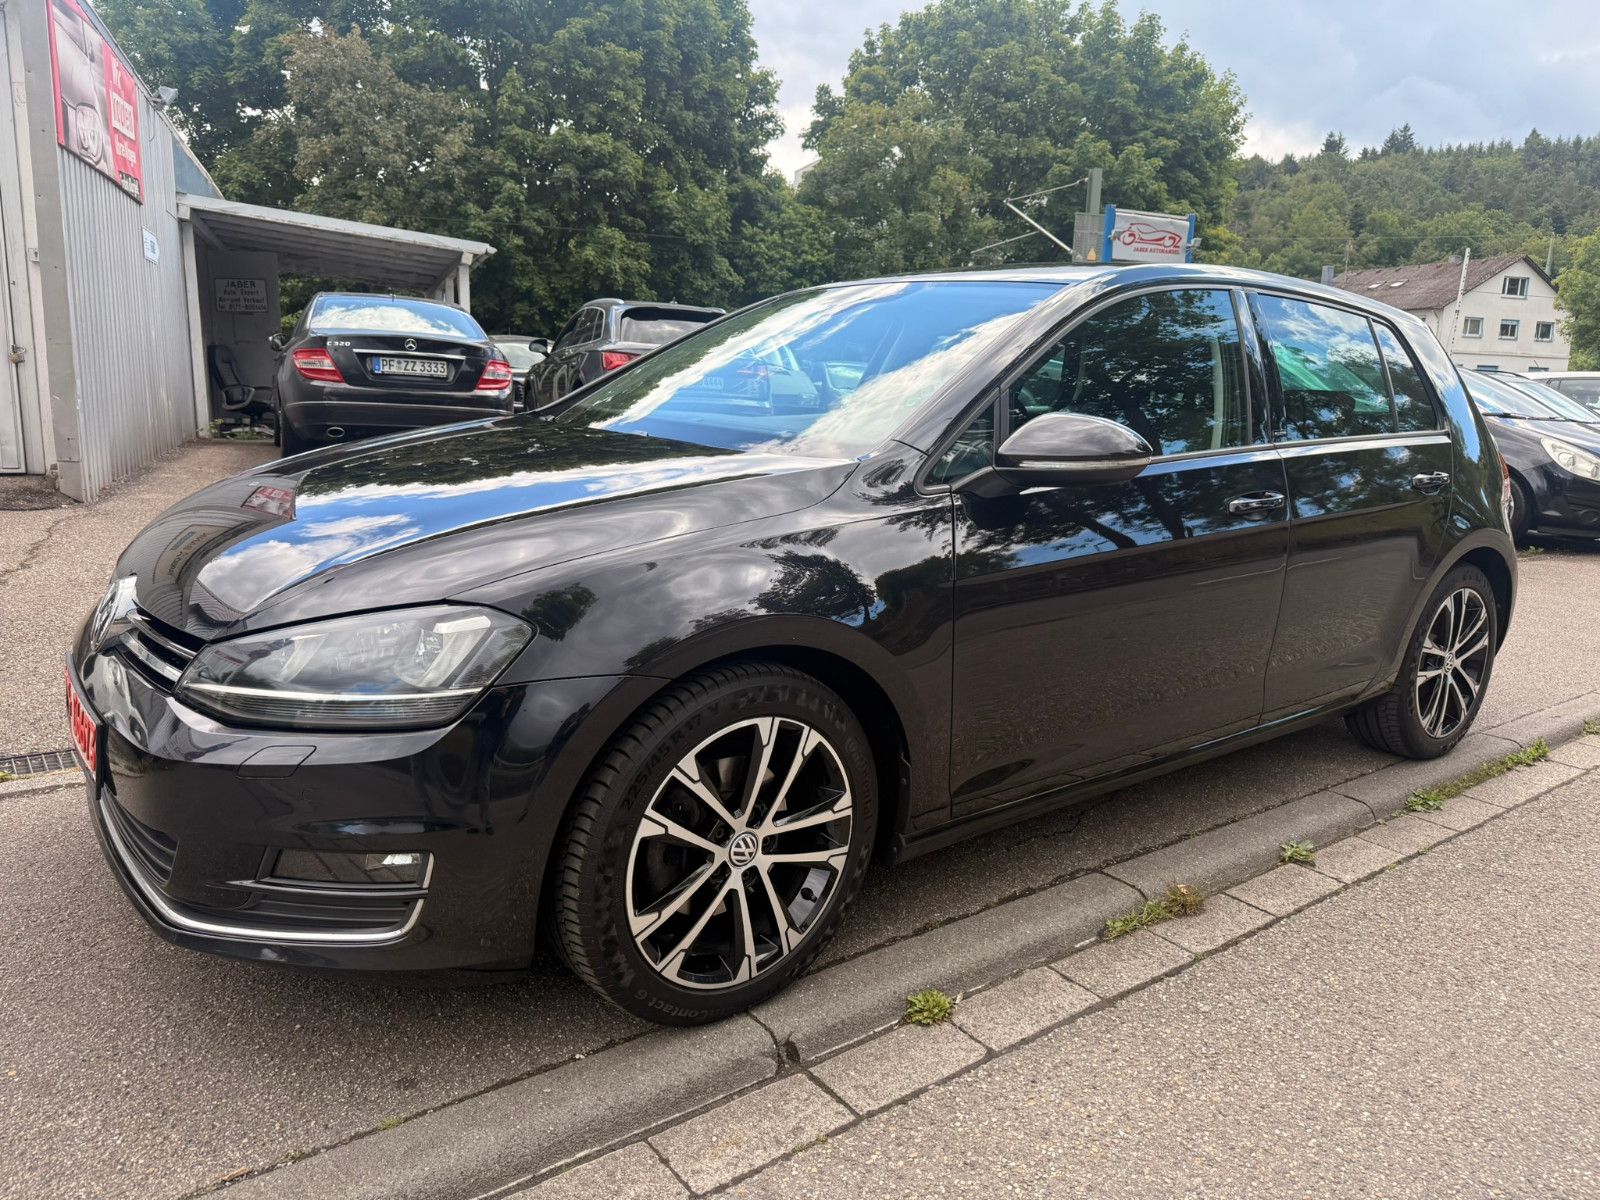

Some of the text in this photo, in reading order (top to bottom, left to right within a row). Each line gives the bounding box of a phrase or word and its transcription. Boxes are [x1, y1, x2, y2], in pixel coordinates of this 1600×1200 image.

[224, 280, 256, 288] JABER
[381, 359, 446, 374] PF ZZ 3333
